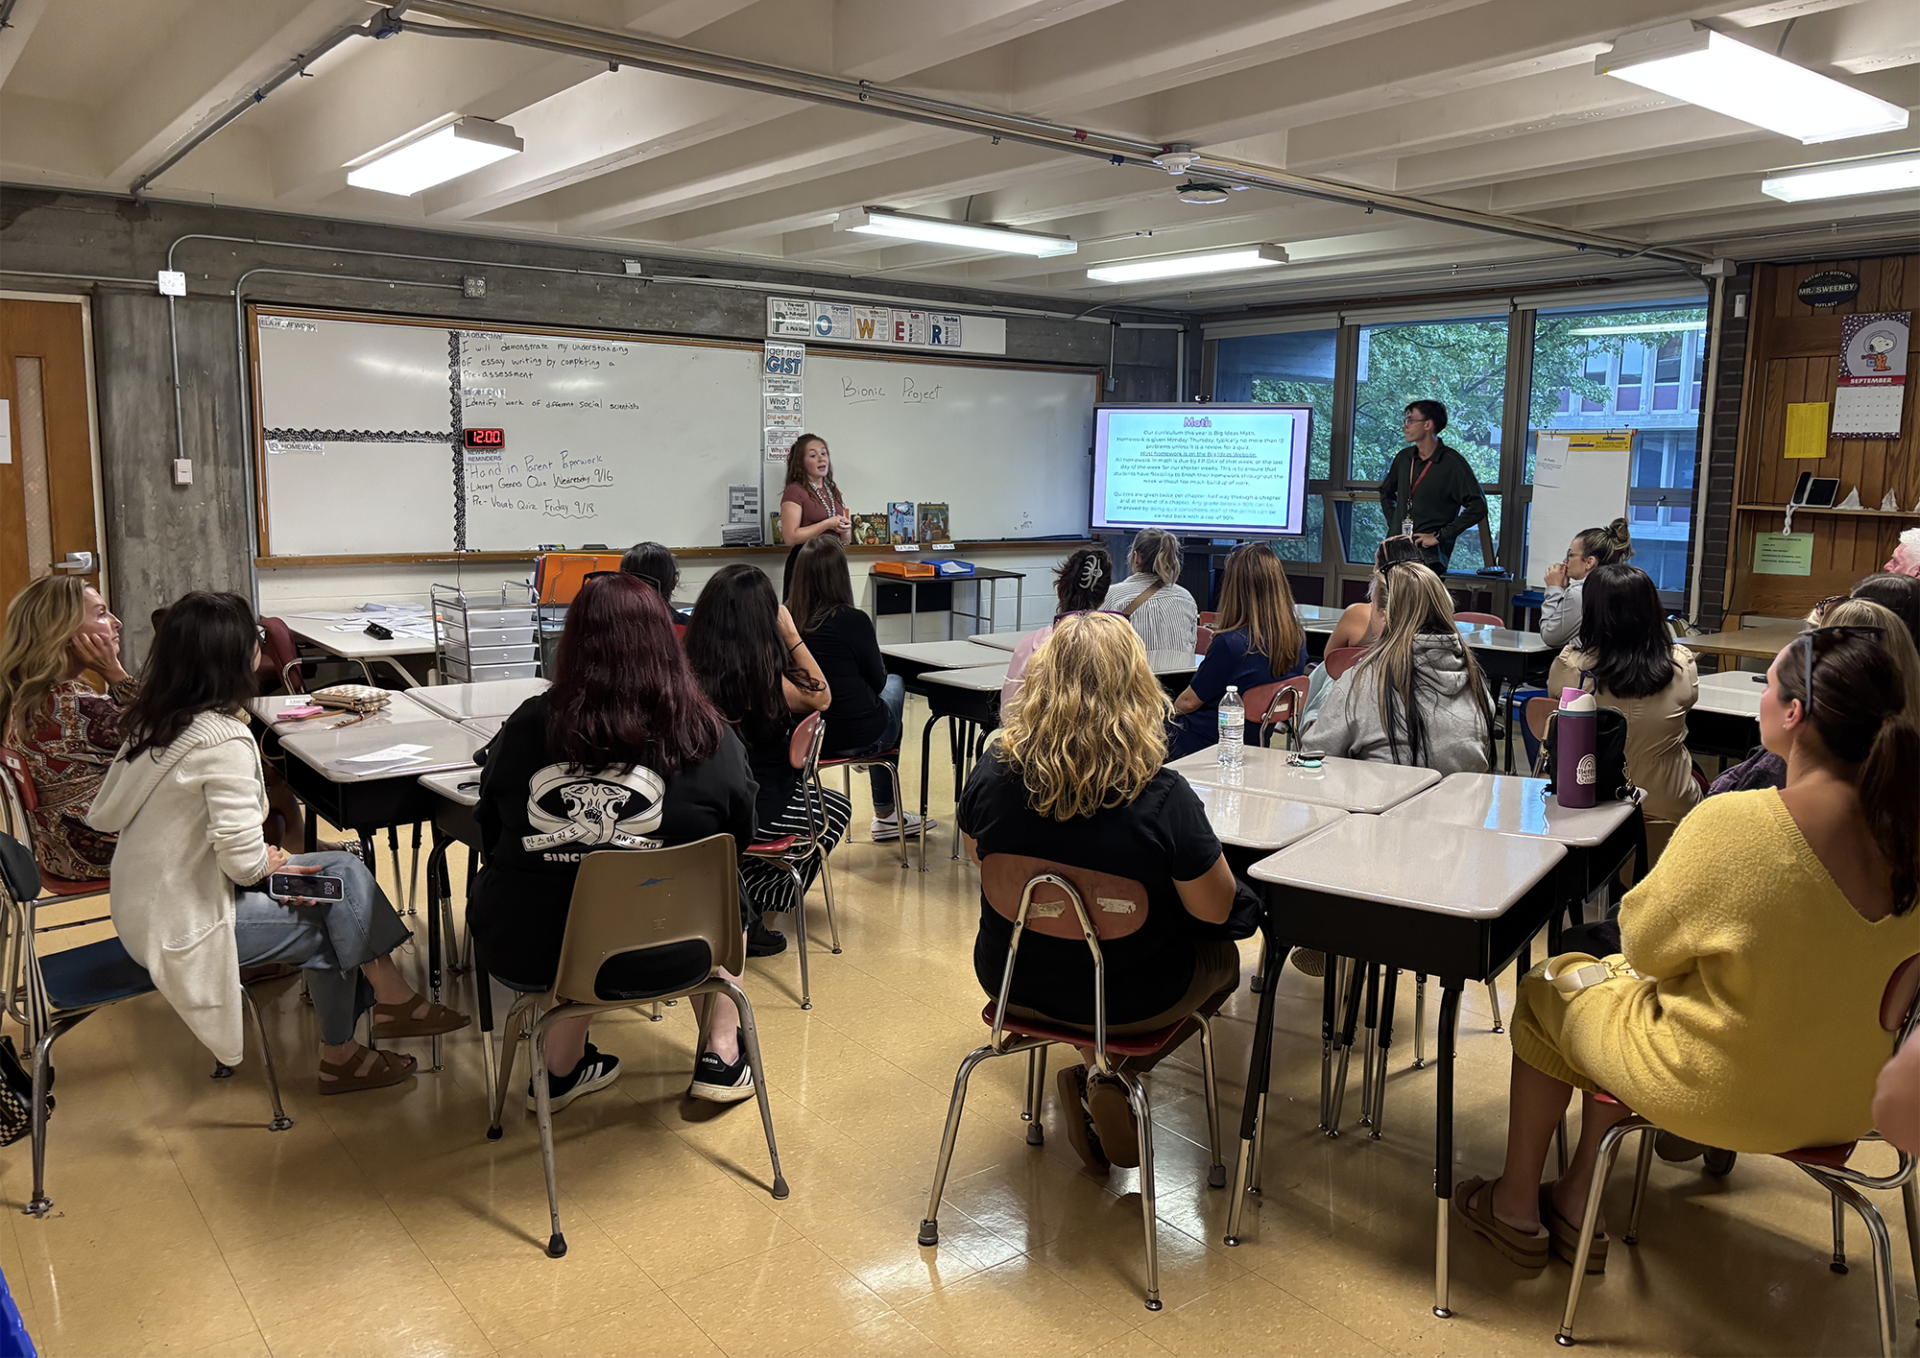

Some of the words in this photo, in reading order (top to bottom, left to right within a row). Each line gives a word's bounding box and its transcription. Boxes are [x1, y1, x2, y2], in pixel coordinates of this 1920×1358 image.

[1816, 283, 1856, 294] SWEENEY
[775, 312, 786, 332] P
[817, 315, 832, 335] O
[857, 319, 875, 339] W
[895, 321, 904, 341] E
[932, 324, 942, 344] R
[462, 341, 469, 353] I
[500, 343, 549, 352] demonstrate
[557, 343, 569, 353] my
[481, 358, 505, 368] essay
[512, 356, 542, 366] writing
[546, 355, 557, 368] by
[560, 359, 600, 369] completing
[766, 356, 802, 374] GIST
[842, 376, 885, 398] Bionic
[903, 377, 942, 403] Project
[1183, 416, 1212, 428] Math
[470, 463, 501, 478] Hand
[508, 464, 518, 474] in
[525, 455, 553, 472] Parent
[560, 450, 603, 469] Paperwork
[594, 468, 613, 482] 9/16
[491, 496, 513, 509] Vocab
[517, 500, 537, 510] Quiz
[544, 499, 568, 514] Friday
[574, 501, 595, 514] 9/18
[526, 827, 579, 848] 안스태권도
[615, 834, 636, 844] AN'S
